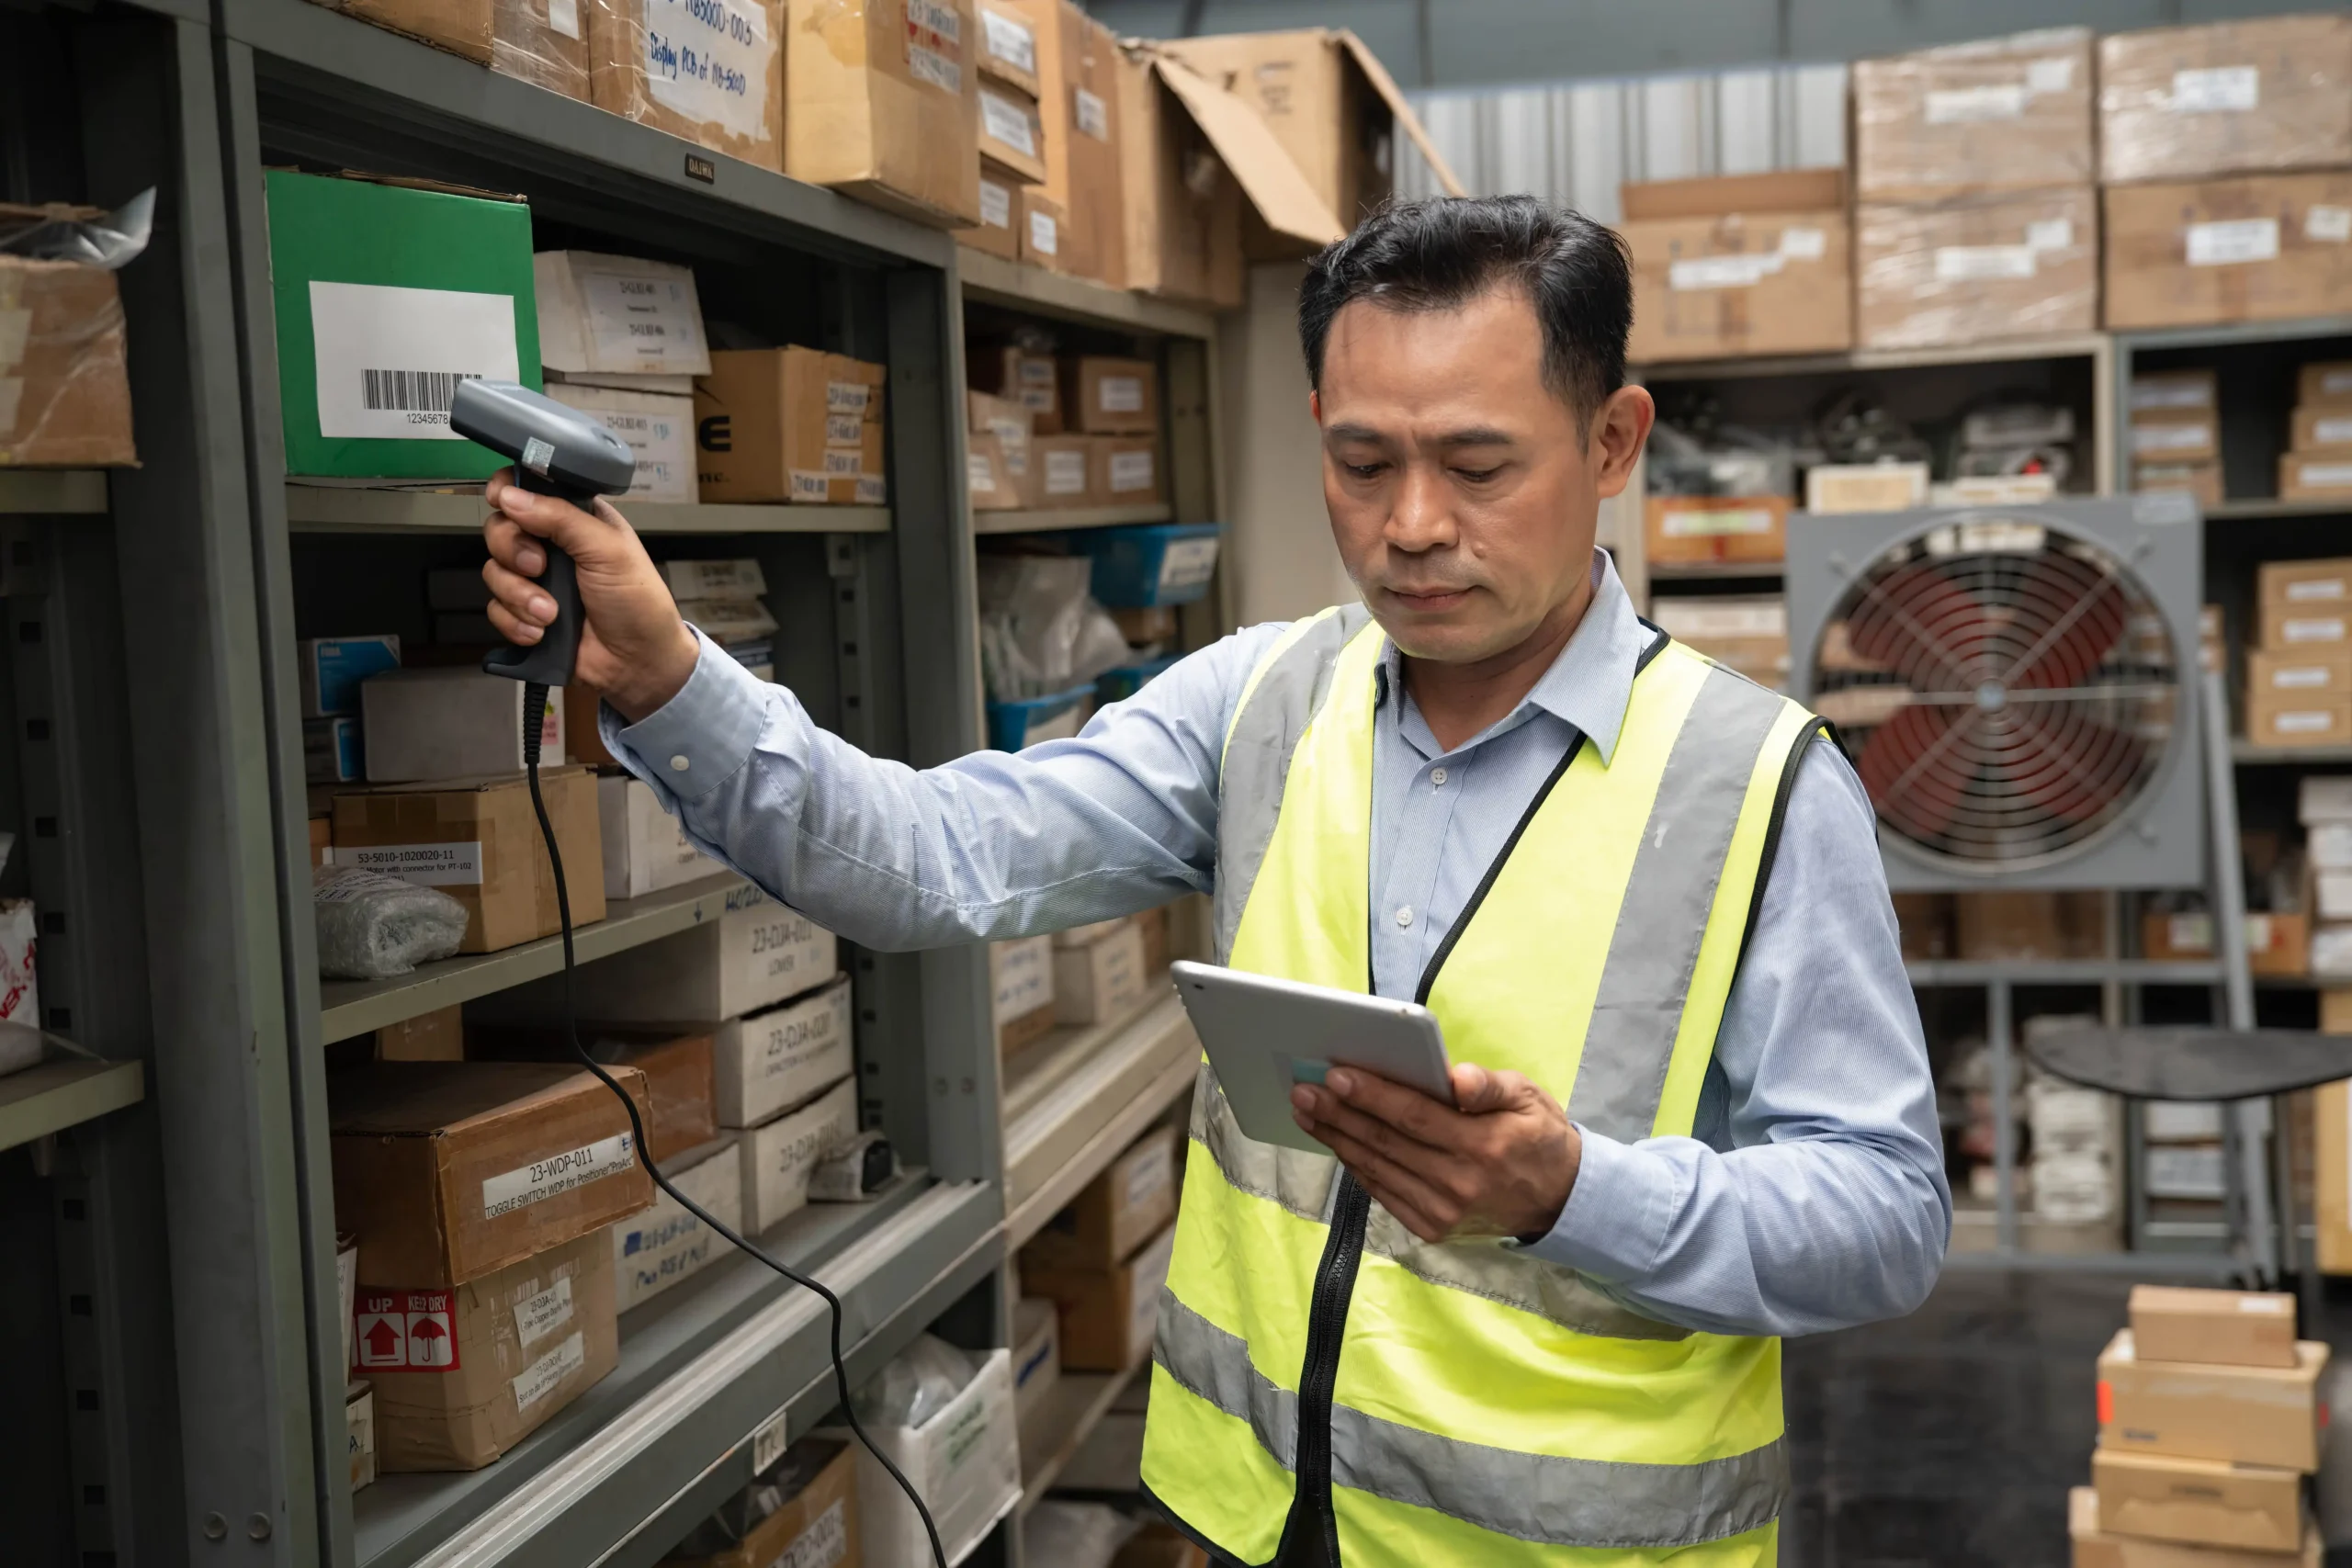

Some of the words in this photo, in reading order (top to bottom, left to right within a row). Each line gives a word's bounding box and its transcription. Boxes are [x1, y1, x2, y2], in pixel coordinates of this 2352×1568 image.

[650, 31, 677, 81] Display
[683, 46, 696, 75] PCB
[699, 52, 709, 81] of
[407, 413, 448, 424] 12345678
[357, 850, 454, 863] 53-5010-1020020-11
[386, 864, 401, 873] with
[402, 864, 435, 873] connector
[530, 1147, 594, 1183] 23-WDP-011
[485, 1197, 516, 1218] TOGGLE
[517, 1186, 547, 1207] SWITCH
[548, 1179, 565, 1195] WDP
[566, 1177, 576, 1189] for
[368, 1297, 392, 1313] UP
[408, 1295, 426, 1311] KEEP
[428, 1295, 447, 1312] DRY
